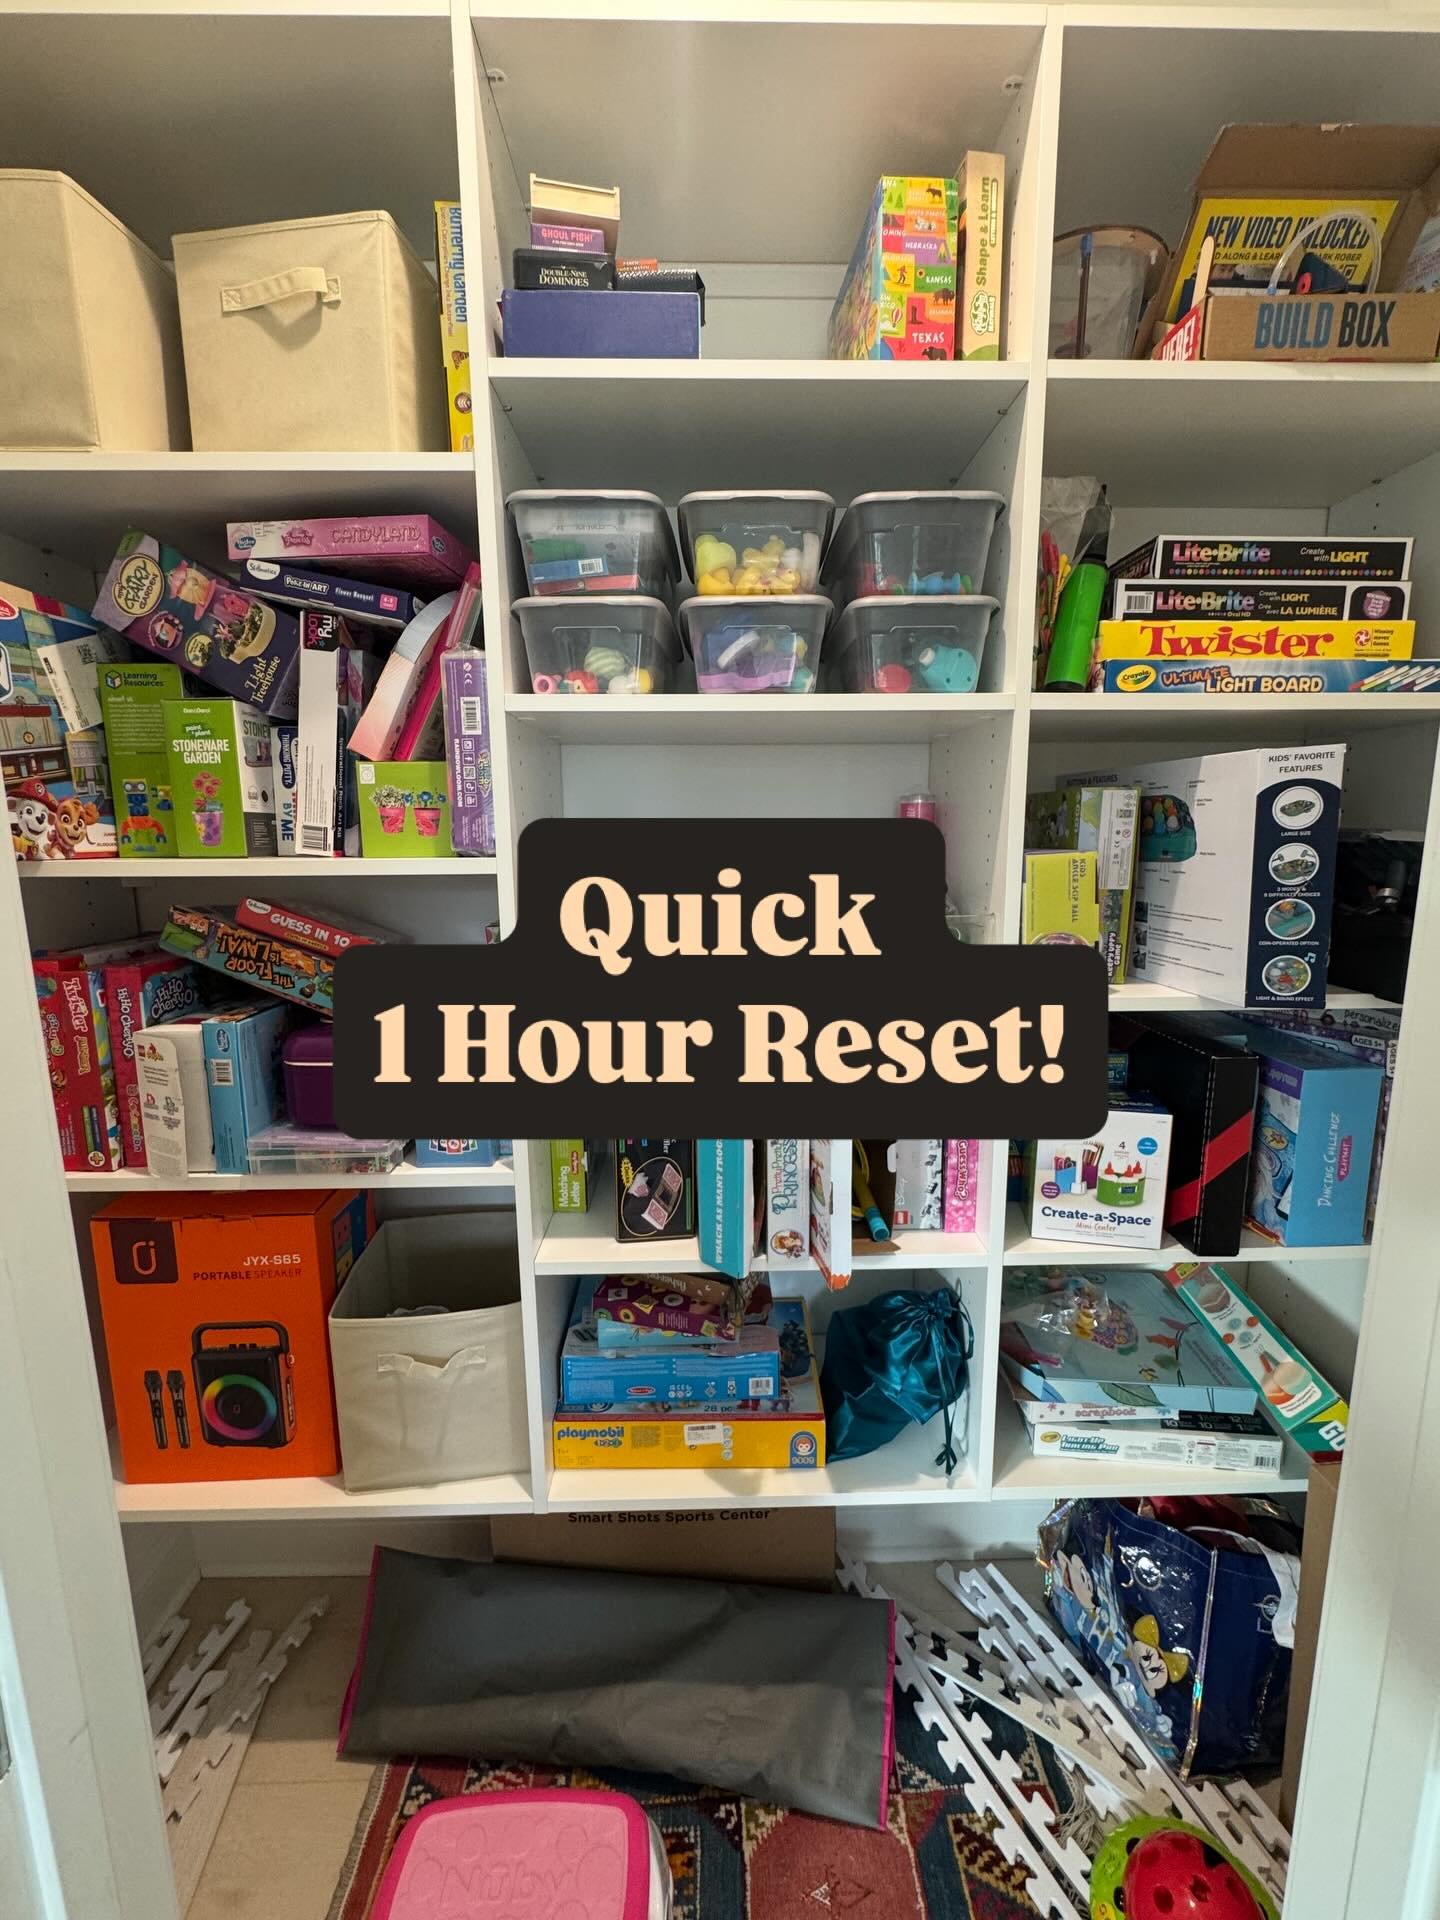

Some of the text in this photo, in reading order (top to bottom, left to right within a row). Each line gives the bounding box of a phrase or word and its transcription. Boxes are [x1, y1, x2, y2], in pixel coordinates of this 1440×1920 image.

[977, 176, 990, 222] Learn
[540, 227, 593, 243] GHOUL FISH!
[980, 226, 989, 238] &
[1206, 216, 1378, 250] NEW VIDEO UNLOCKED
[904, 241, 938, 251] NEBRASKA
[1220, 252, 1250, 261] ALONG
[1333, 253, 1362, 262] ROBER
[540, 267, 587, 278] DOUBLE-NINE
[975, 245, 989, 287] Shape
[538, 274, 590, 288] DOMINOES
[925, 274, 953, 285] KANSAS
[1254, 301, 1397, 349] BUILD BOX
[911, 332, 945, 344] TEXAS
[330, 525, 422, 544] CANDYLAND
[1300, 547, 1325, 555] Create
[1313, 554, 1330, 562] with
[124, 559, 152, 611] FAIRY
[139, 573, 159, 610] GARDEN
[311, 582, 329, 594] ART
[1258, 589, 1278, 597] Create
[1279, 606, 1294, 615] LA
[1295, 604, 1338, 616] LUMIÈRE
[317, 614, 333, 639] my
[1140, 624, 1335, 659] Twister
[123, 672, 158, 682] Learning
[244, 656, 267, 690] Light
[249, 655, 281, 704] Treehouse
[1122, 669, 1151, 682] Crayola
[1161, 666, 1230, 685] ULTIMATE
[123, 679, 165, 688] Resources
[1260, 676, 1323, 693] BOARD
[185, 724, 202, 733] paint
[172, 738, 230, 752] STONEWARE
[183, 751, 222, 765] GARDEN
[280, 733, 294, 785] THINKING PUTTY
[1268, 751, 1336, 763] KIDS' FAVORITE
[453, 738, 464, 808] RAINBOWLOOM.COM
[1279, 764, 1323, 774] FEATURES
[281, 802, 294, 842] BY ME
[270, 914, 351, 948] GUESS IN 10
[218, 935, 272, 961] LAVA!
[225, 957, 274, 982] FLOOR
[273, 976, 295, 989] THE
[62, 976, 89, 1034] Twister
[1353, 1036, 1383, 1048] AGES 5+
[1389, 1043, 1397, 1065] AGES
[1118, 1141, 1126, 1150] 4
[1338, 1143, 1350, 1177] PLAYMAT
[558, 1165, 571, 1208] Matching
[715, 1173, 723, 1207] MANY
[570, 1180, 581, 1208] Letter
[715, 1206, 723, 1222] AS
[1041, 1206, 1152, 1226] Create-a-Space
[1075, 1222, 1092, 1230] Mini
[1093, 1223, 1117, 1232] Center
[715, 1223, 723, 1264] WHACK
[193, 1268, 301, 1281] PORTABLE SPEAKER
[703, 1404, 718, 1413] 28
[1074, 1406, 1137, 1418] scrapbook
[1163, 1419, 1177, 1428] 10
[1200, 1421, 1213, 1430] 10
[1229, 1415, 1241, 1424] 12
[557, 1427, 625, 1440] playmobil
[568, 1509, 770, 1524] Smart Shots Sports Center
